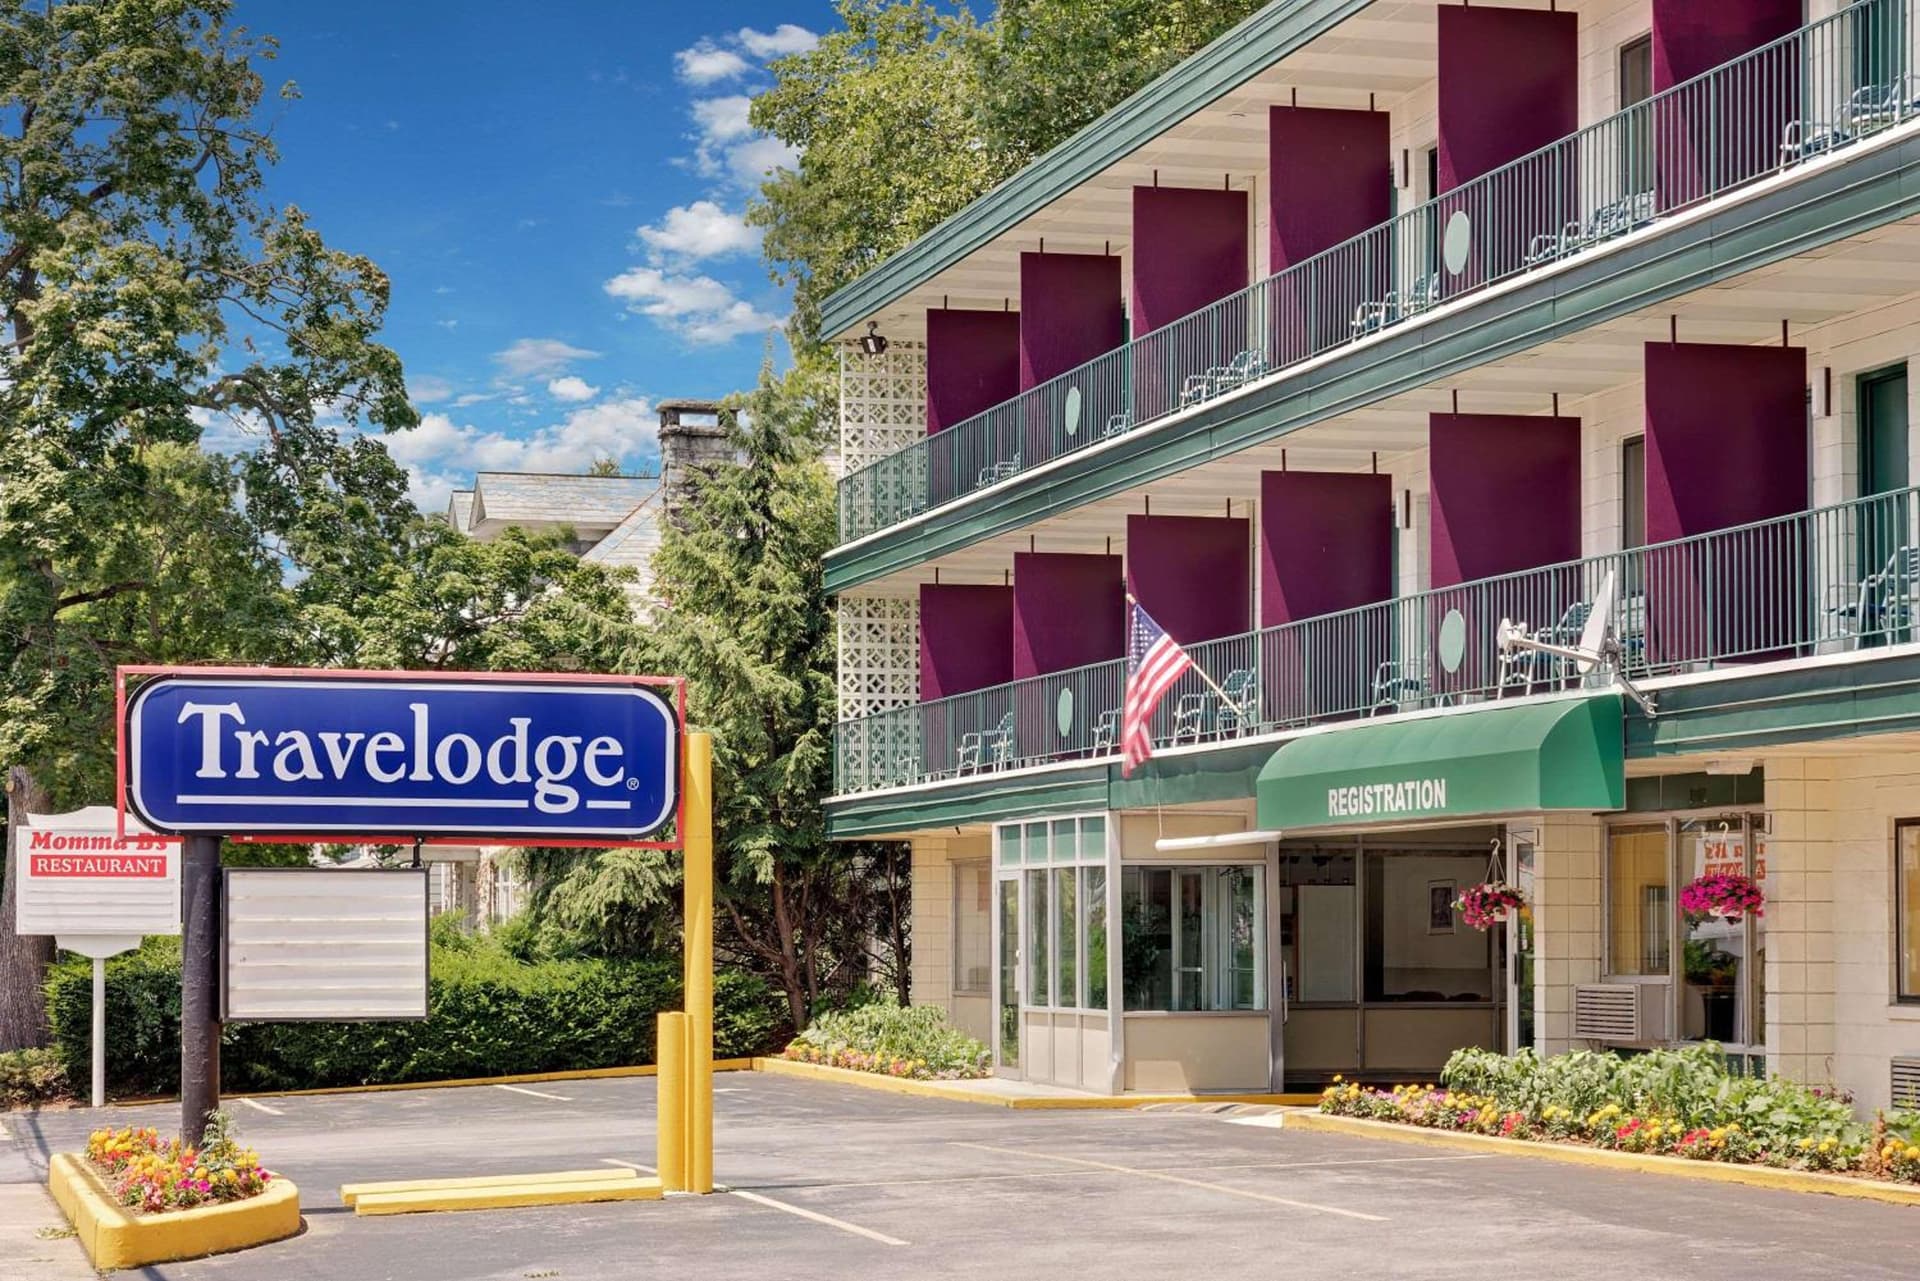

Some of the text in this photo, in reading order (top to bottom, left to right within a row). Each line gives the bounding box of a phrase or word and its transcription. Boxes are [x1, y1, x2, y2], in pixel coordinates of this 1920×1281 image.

[177, 702, 625, 813] Travelodge
[1328, 778, 1446, 817] REGISTRATION
[36, 858, 162, 873] RESTAURANT
